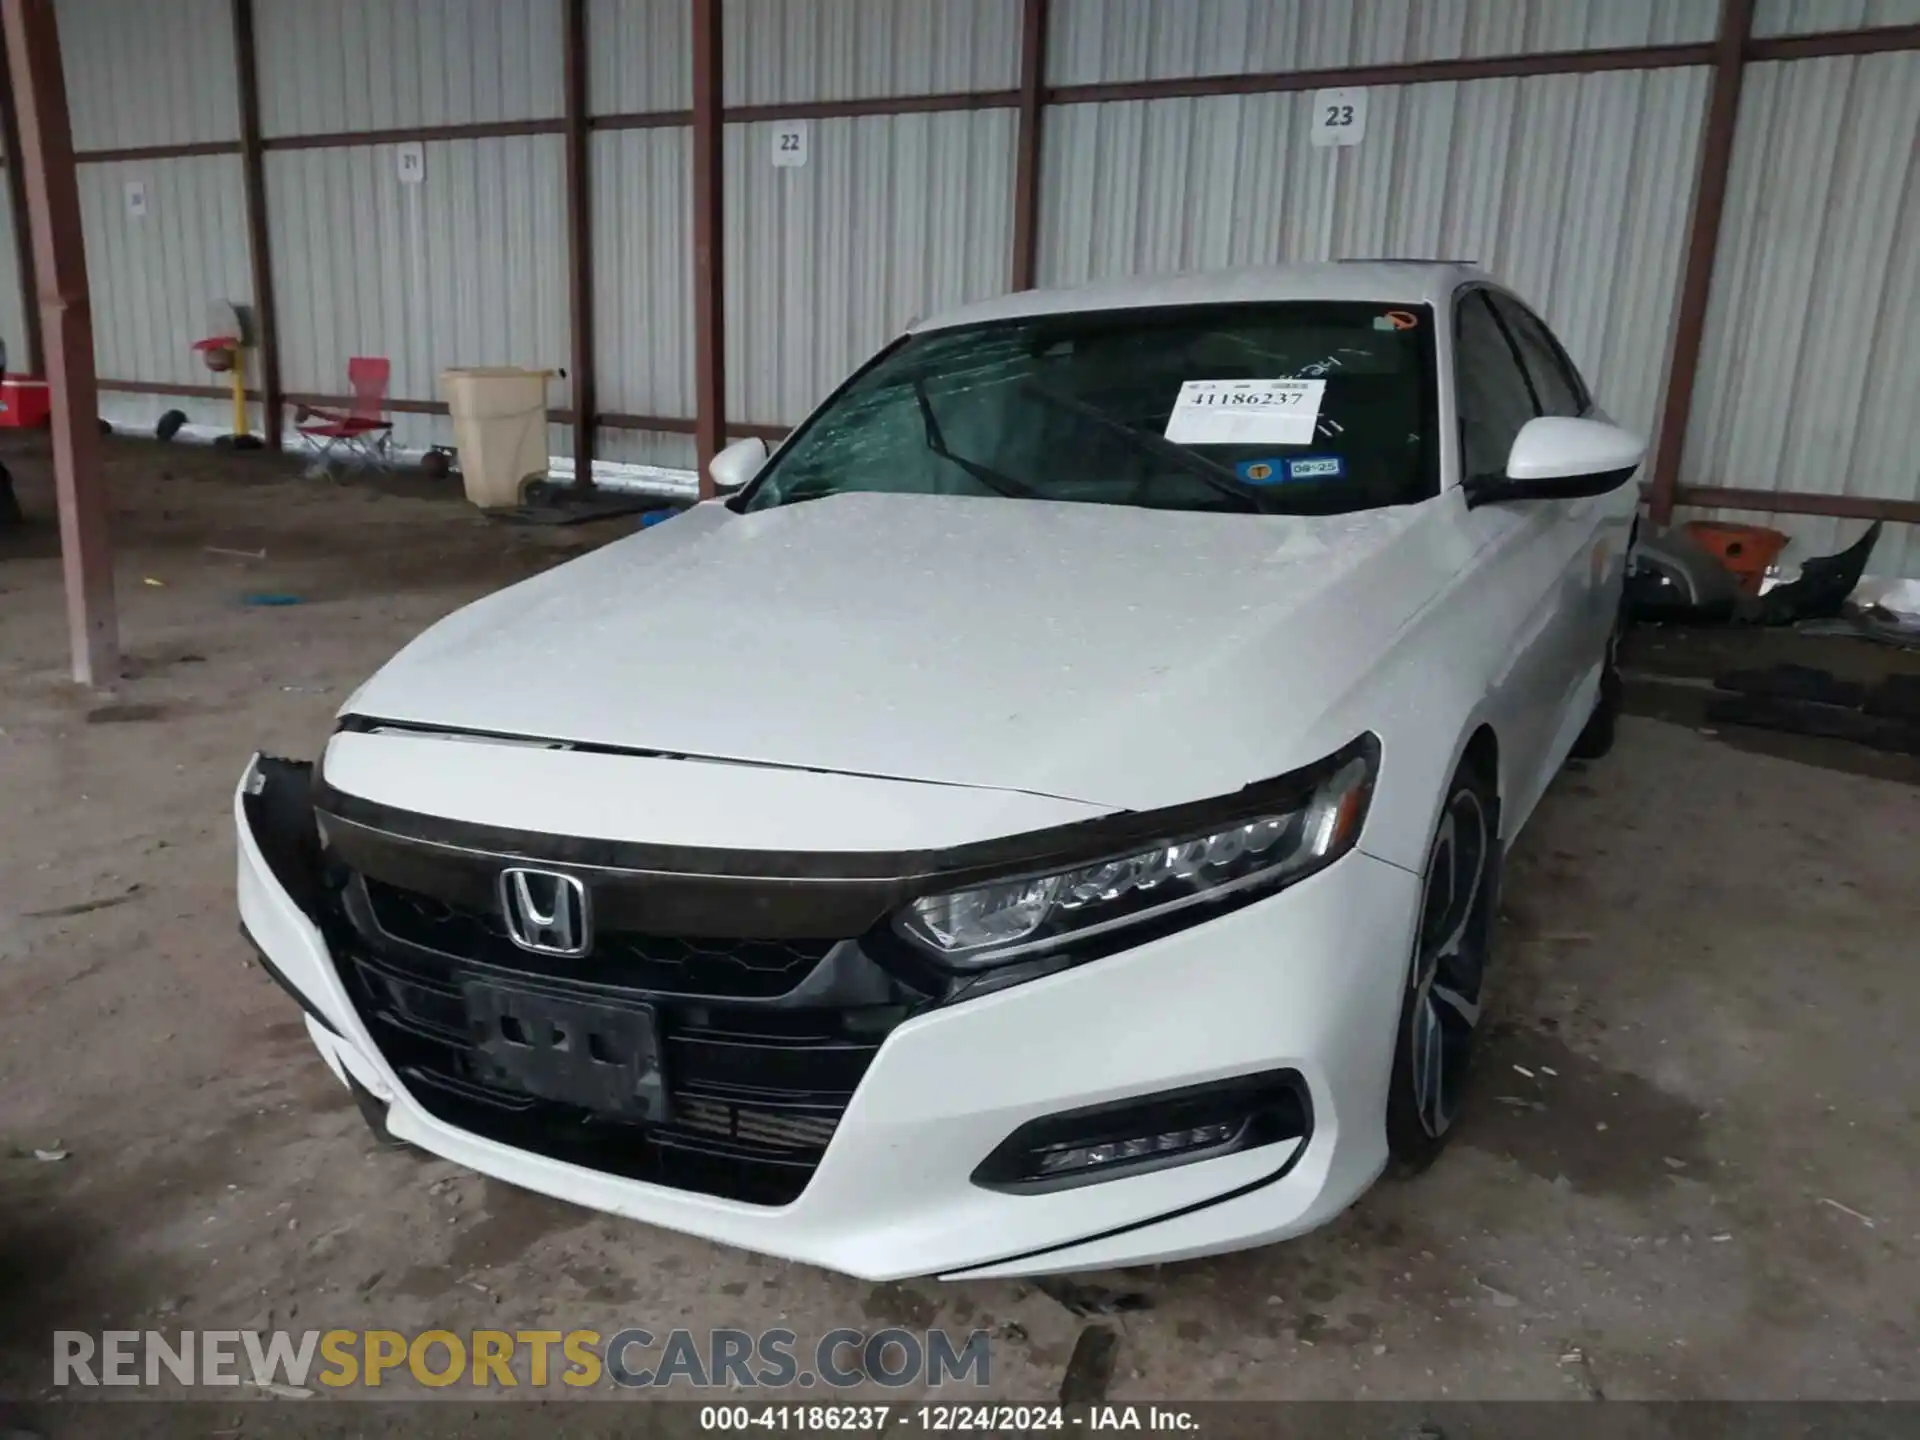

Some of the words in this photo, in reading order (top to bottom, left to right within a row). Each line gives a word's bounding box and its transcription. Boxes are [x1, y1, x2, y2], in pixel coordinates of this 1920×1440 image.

[1325, 105, 1354, 127] 23
[780, 133, 800, 151] 22
[1191, 392, 1303, 405] 41186237
